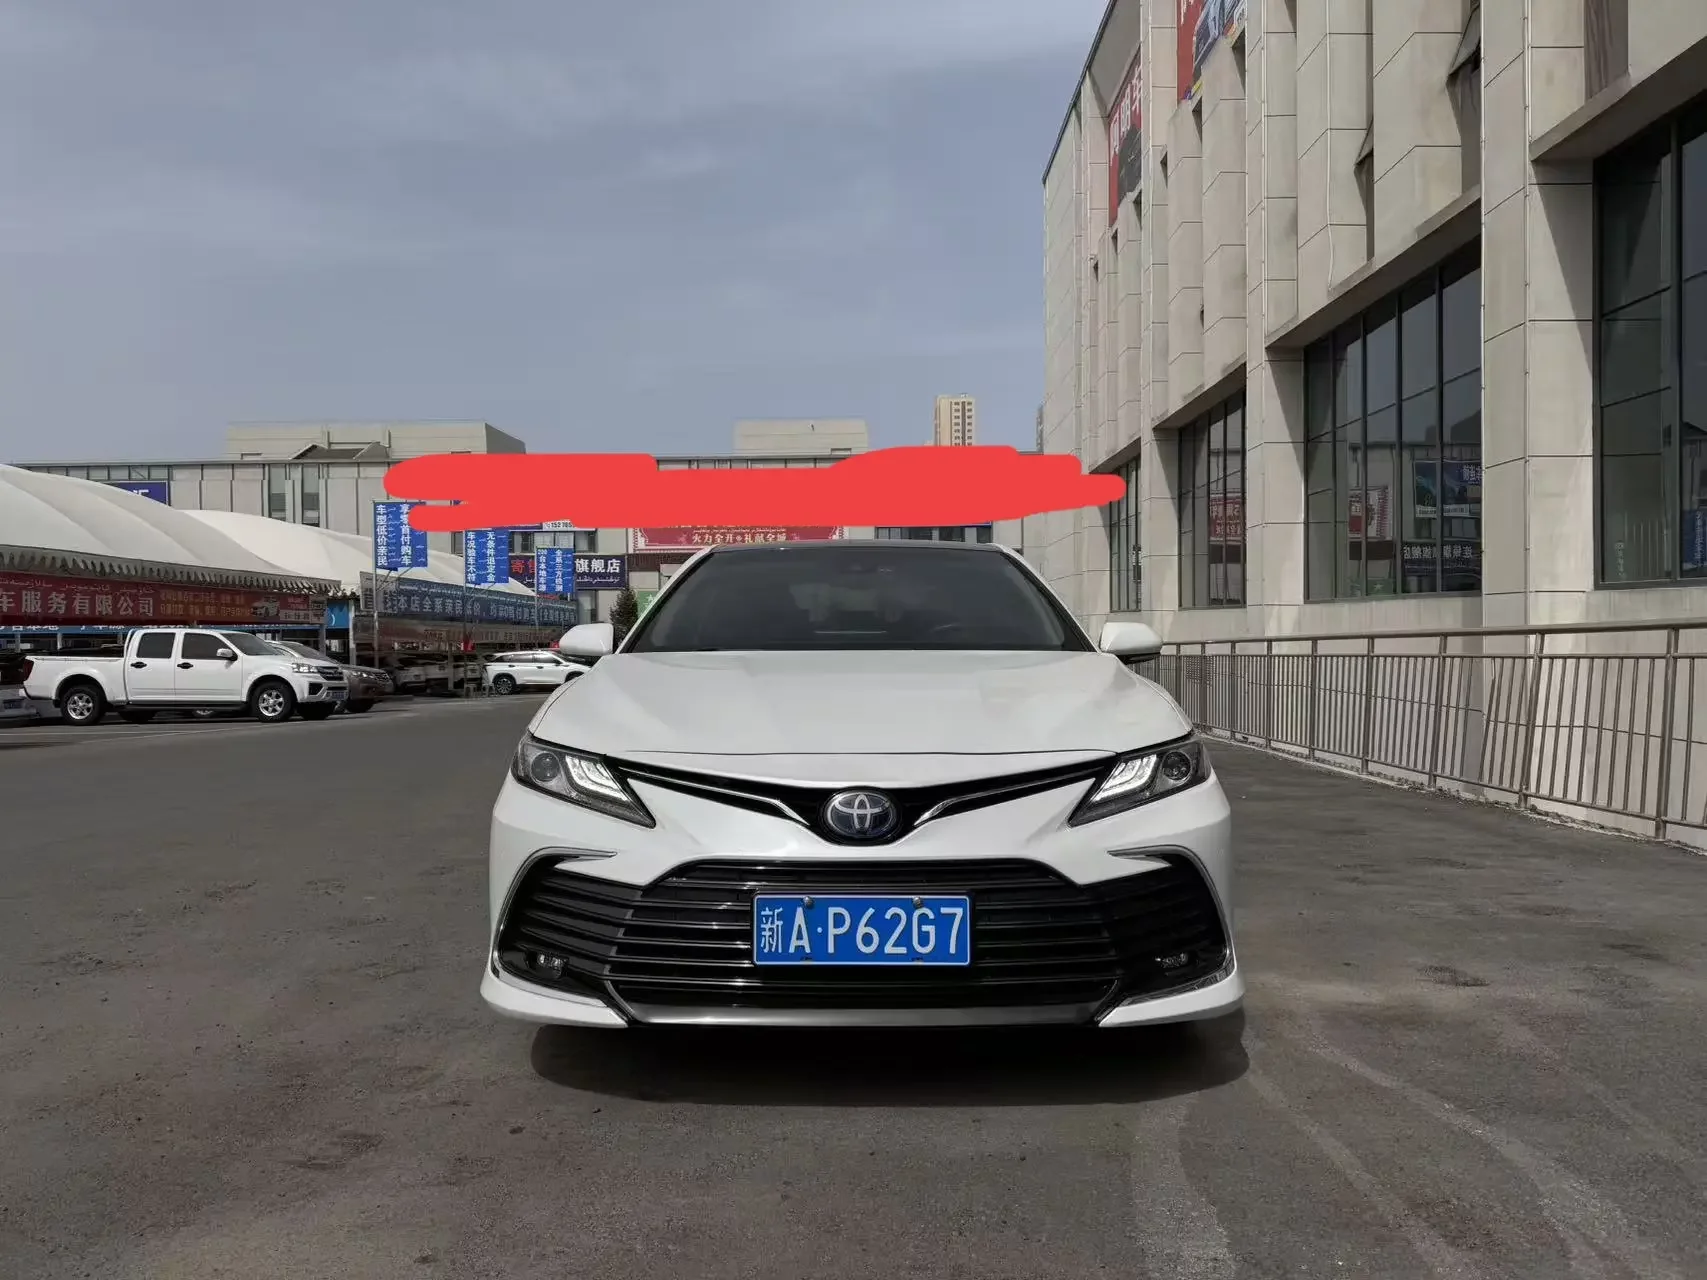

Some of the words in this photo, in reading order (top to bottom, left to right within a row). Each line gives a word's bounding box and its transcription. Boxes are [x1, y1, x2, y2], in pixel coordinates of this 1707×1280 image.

[376, 504, 388, 566] 车型低价亲民
[486, 531, 496, 582] 无条件退定金
[575, 558, 621, 573] 旗舰店
[0, 587, 155, 617] 车服务有限公司
[760, 906, 964, 955] 新A·P62G7
